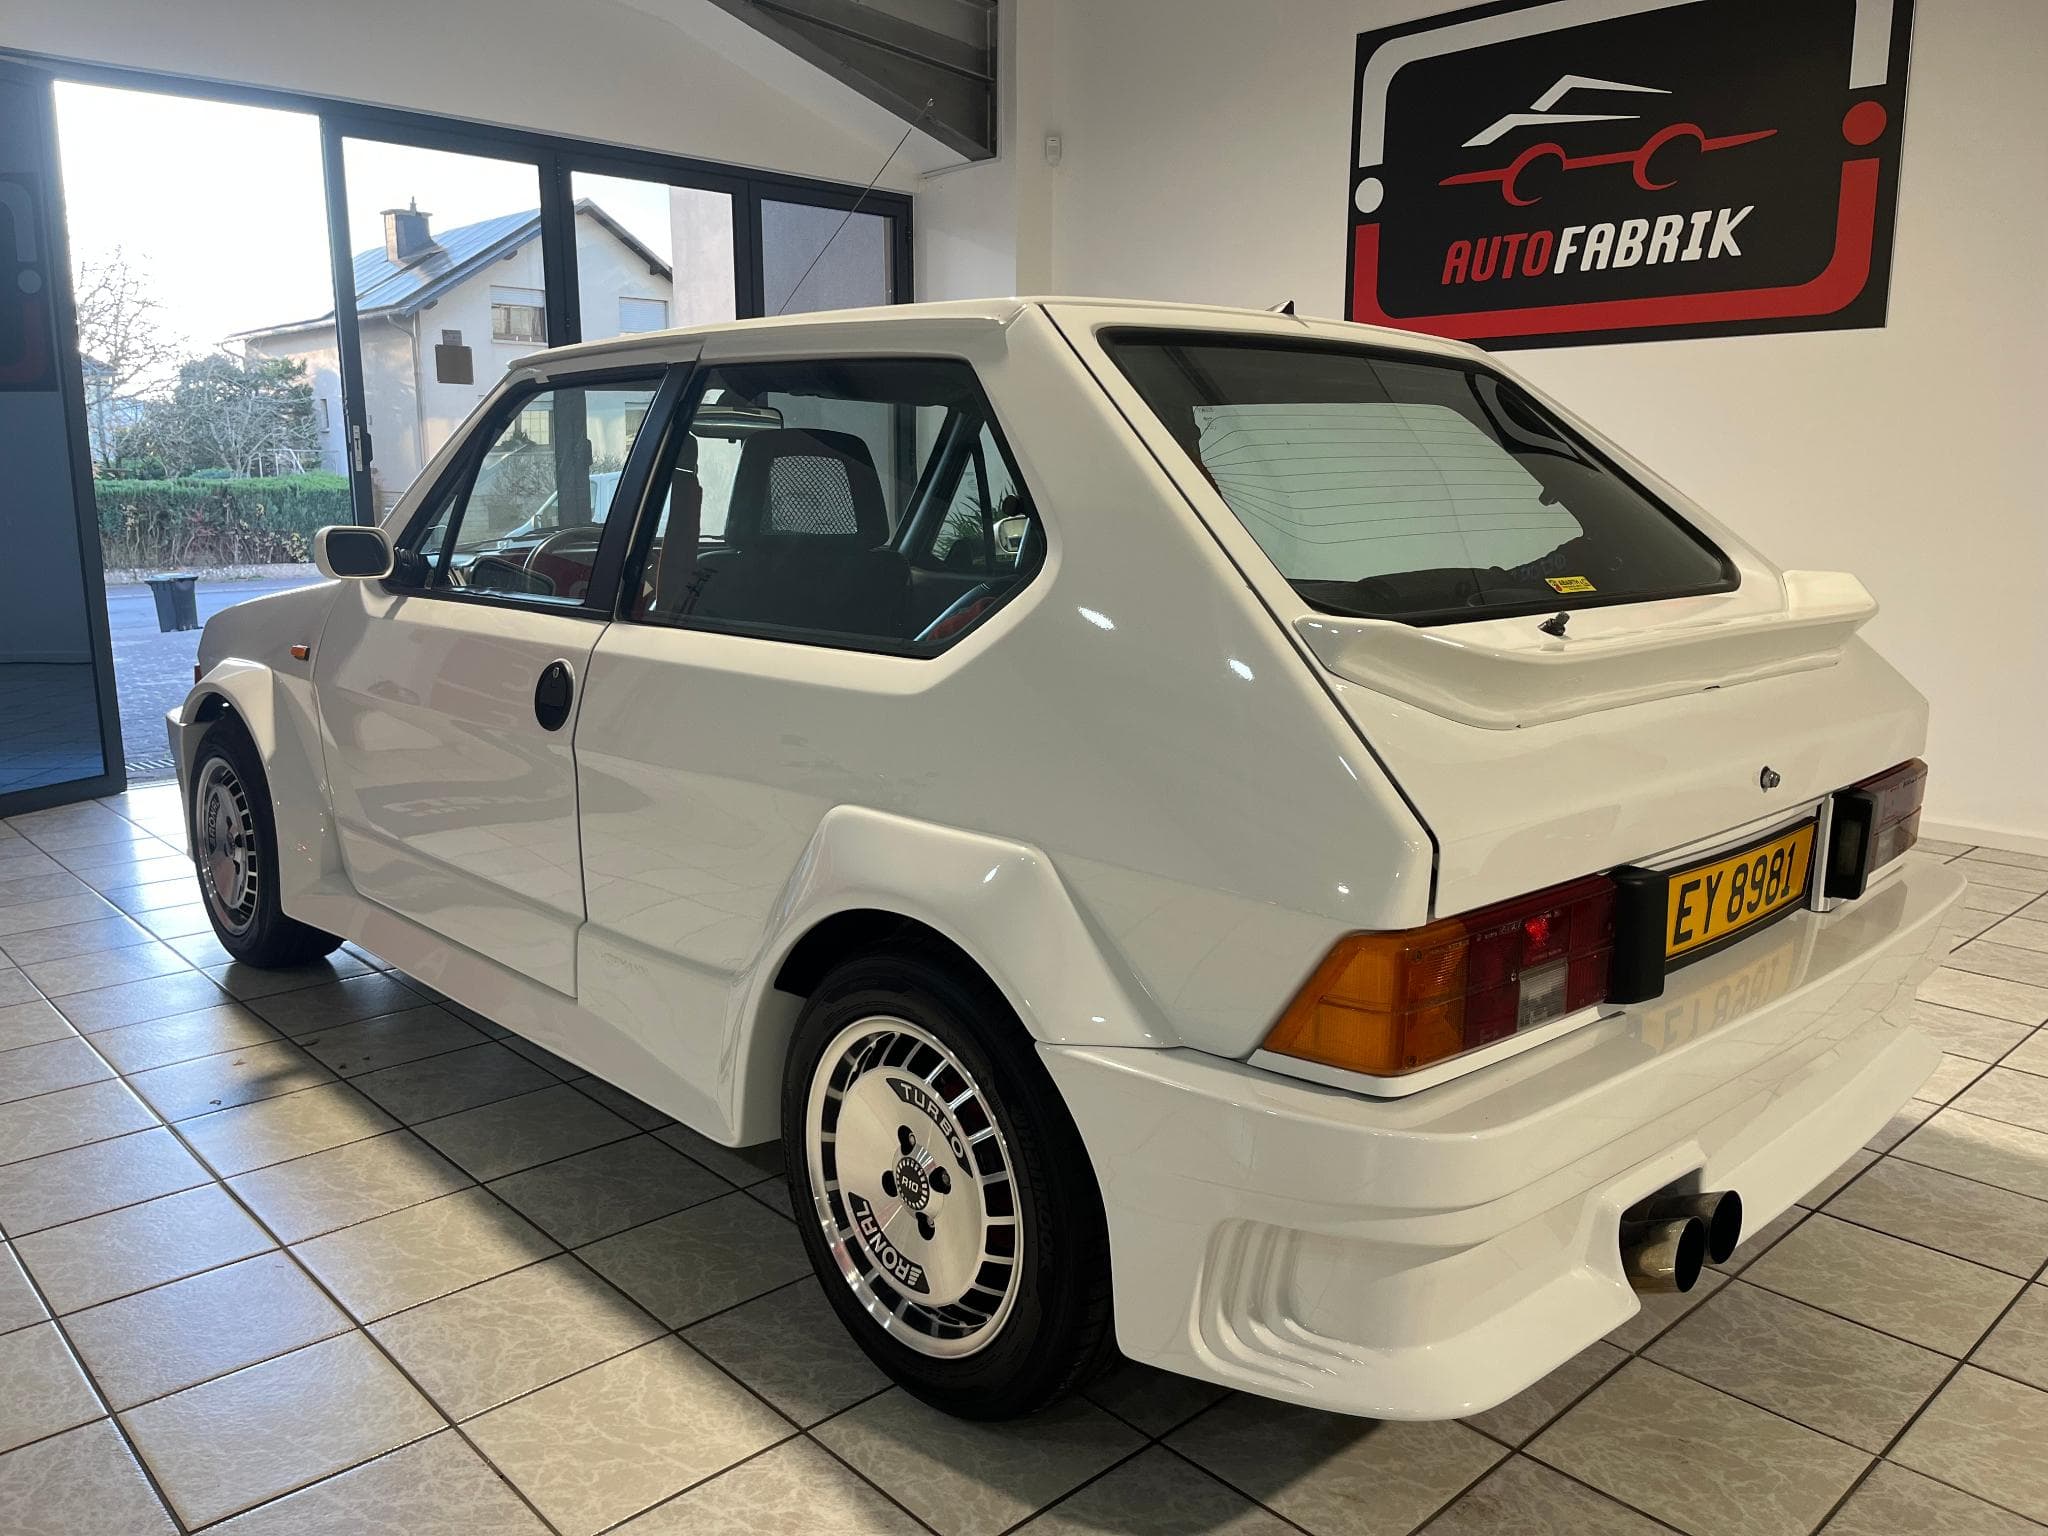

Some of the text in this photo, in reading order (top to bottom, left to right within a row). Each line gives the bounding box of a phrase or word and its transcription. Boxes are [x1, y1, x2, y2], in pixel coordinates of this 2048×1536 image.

[1441, 206, 1755, 285] AUTOFABRIK
[900, 1082, 964, 1159] TURBO
[855, 1200, 912, 1282] RONAL
